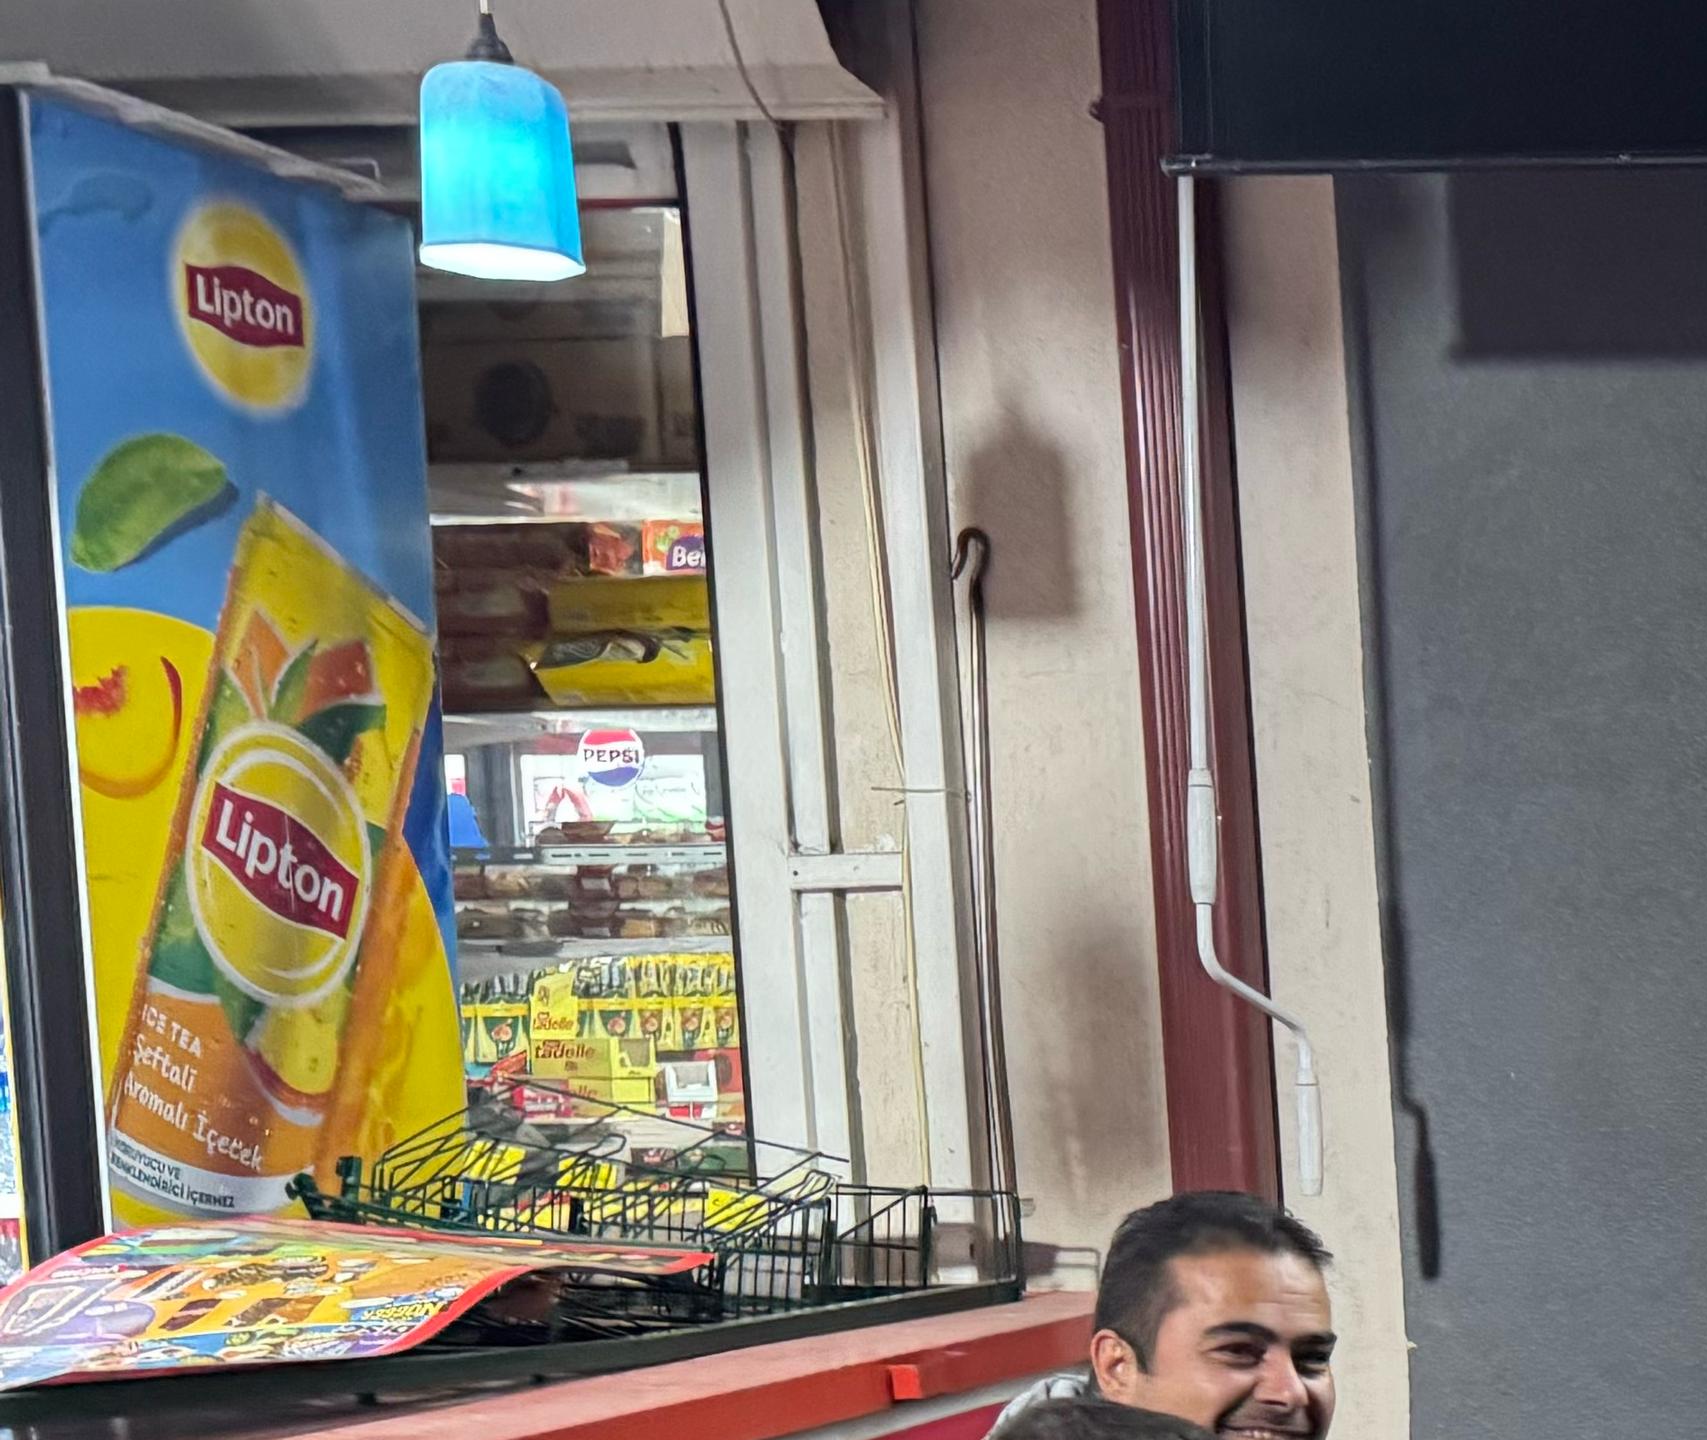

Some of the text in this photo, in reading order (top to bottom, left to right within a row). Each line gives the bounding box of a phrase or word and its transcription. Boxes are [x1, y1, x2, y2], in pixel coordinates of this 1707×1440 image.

[195, 273, 294, 336] Lipton
[584, 748, 639, 764] PEPSI
[205, 798, 344, 923] Lipton
[142, 1003, 201, 1058] ICE TEA
